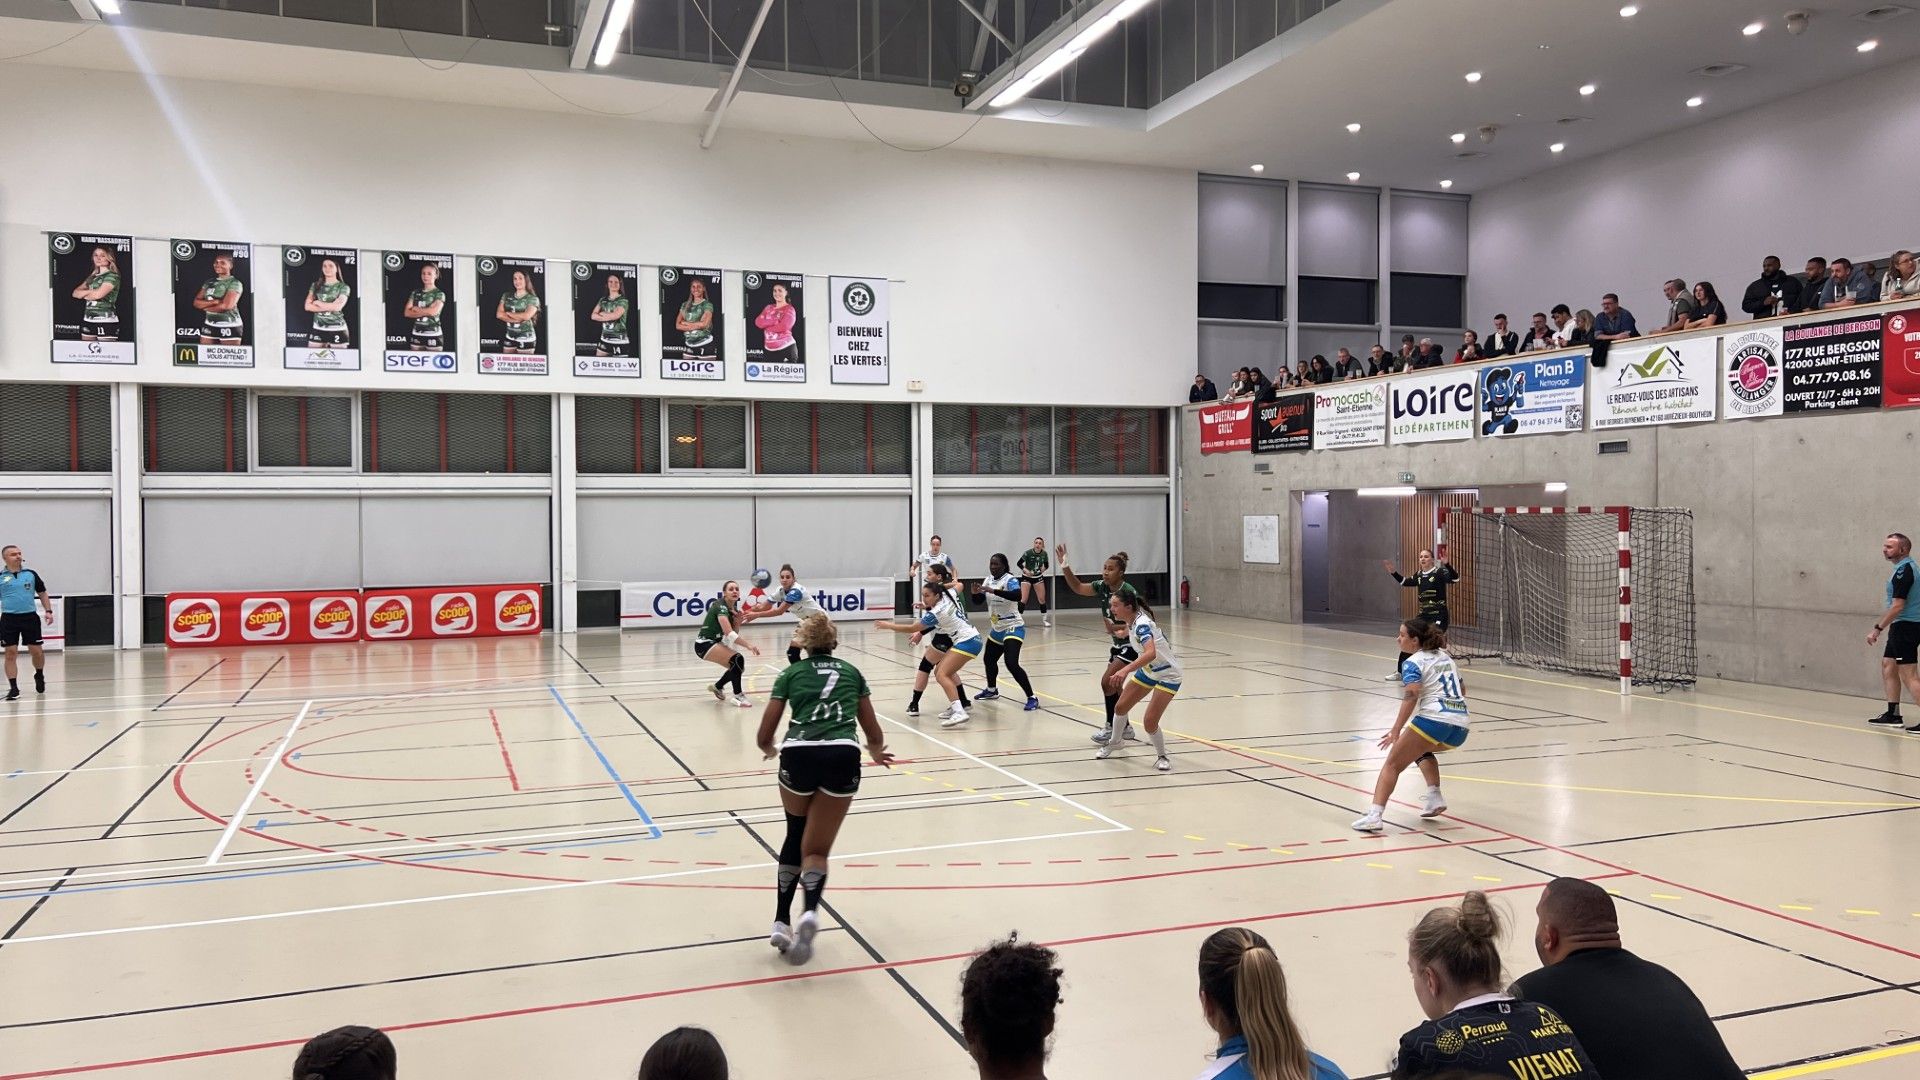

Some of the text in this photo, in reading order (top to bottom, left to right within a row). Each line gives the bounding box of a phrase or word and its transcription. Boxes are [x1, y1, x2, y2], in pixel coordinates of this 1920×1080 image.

[177, 328, 201, 336] GIZA
[221, 328, 232, 337] 90
[837, 326, 883, 337] BIENVENUE
[1785, 319, 1881, 342] LA BOULANGE DE BERGSON
[848, 341, 870, 351] CHEZ
[1785, 339, 1880, 360] 177 RUE BERGSON
[833, 355, 849, 365] LES
[851, 355, 882, 366] VERTES
[1737, 346, 1770, 363] ARTISAN
[1785, 352, 1880, 369] 42000 SAINT-ÉTIENNE
[670, 361, 715, 373] Loire
[773, 366, 804, 375] Région
[1534, 359, 1575, 378] Plan B
[1793, 368, 1871, 386] 04.77.79.08.16
[1607, 386, 1700, 405] LE RENDEZ-VOUS DES ARTISANS
[1732, 380, 1775, 400] BOULANGER
[1785, 391, 1814, 401] OUVERT
[1816, 389, 1835, 400] 7J/7
[1842, 388, 1854, 397] 6H
[1863, 386, 1881, 396] 20H
[1316, 389, 1372, 408] Promocash
[1393, 383, 1474, 419] Loire
[1804, 397, 1859, 409] Parking client
[1261, 406, 1278, 421] sport
[1337, 404, 1373, 414] Saint-Etienne
[1214, 410, 1236, 423] BUFFALO
[318, 609, 352, 623] SCOOP
[373, 609, 406, 623] SCOOP
[439, 606, 471, 619] SCOOP
[502, 604, 534, 617] SCOOP
[178, 611, 213, 626] SCOOP
[248, 611, 284, 625] SCOOP
[811, 661, 842, 669] LOPES
[817, 669, 840, 699] 7
[1438, 673, 1459, 699] 11
[1461, 1020, 1508, 1041] Perraud
[1530, 1026, 1559, 1039] MAKE
[1508, 1047, 1584, 1080] VIENAT
